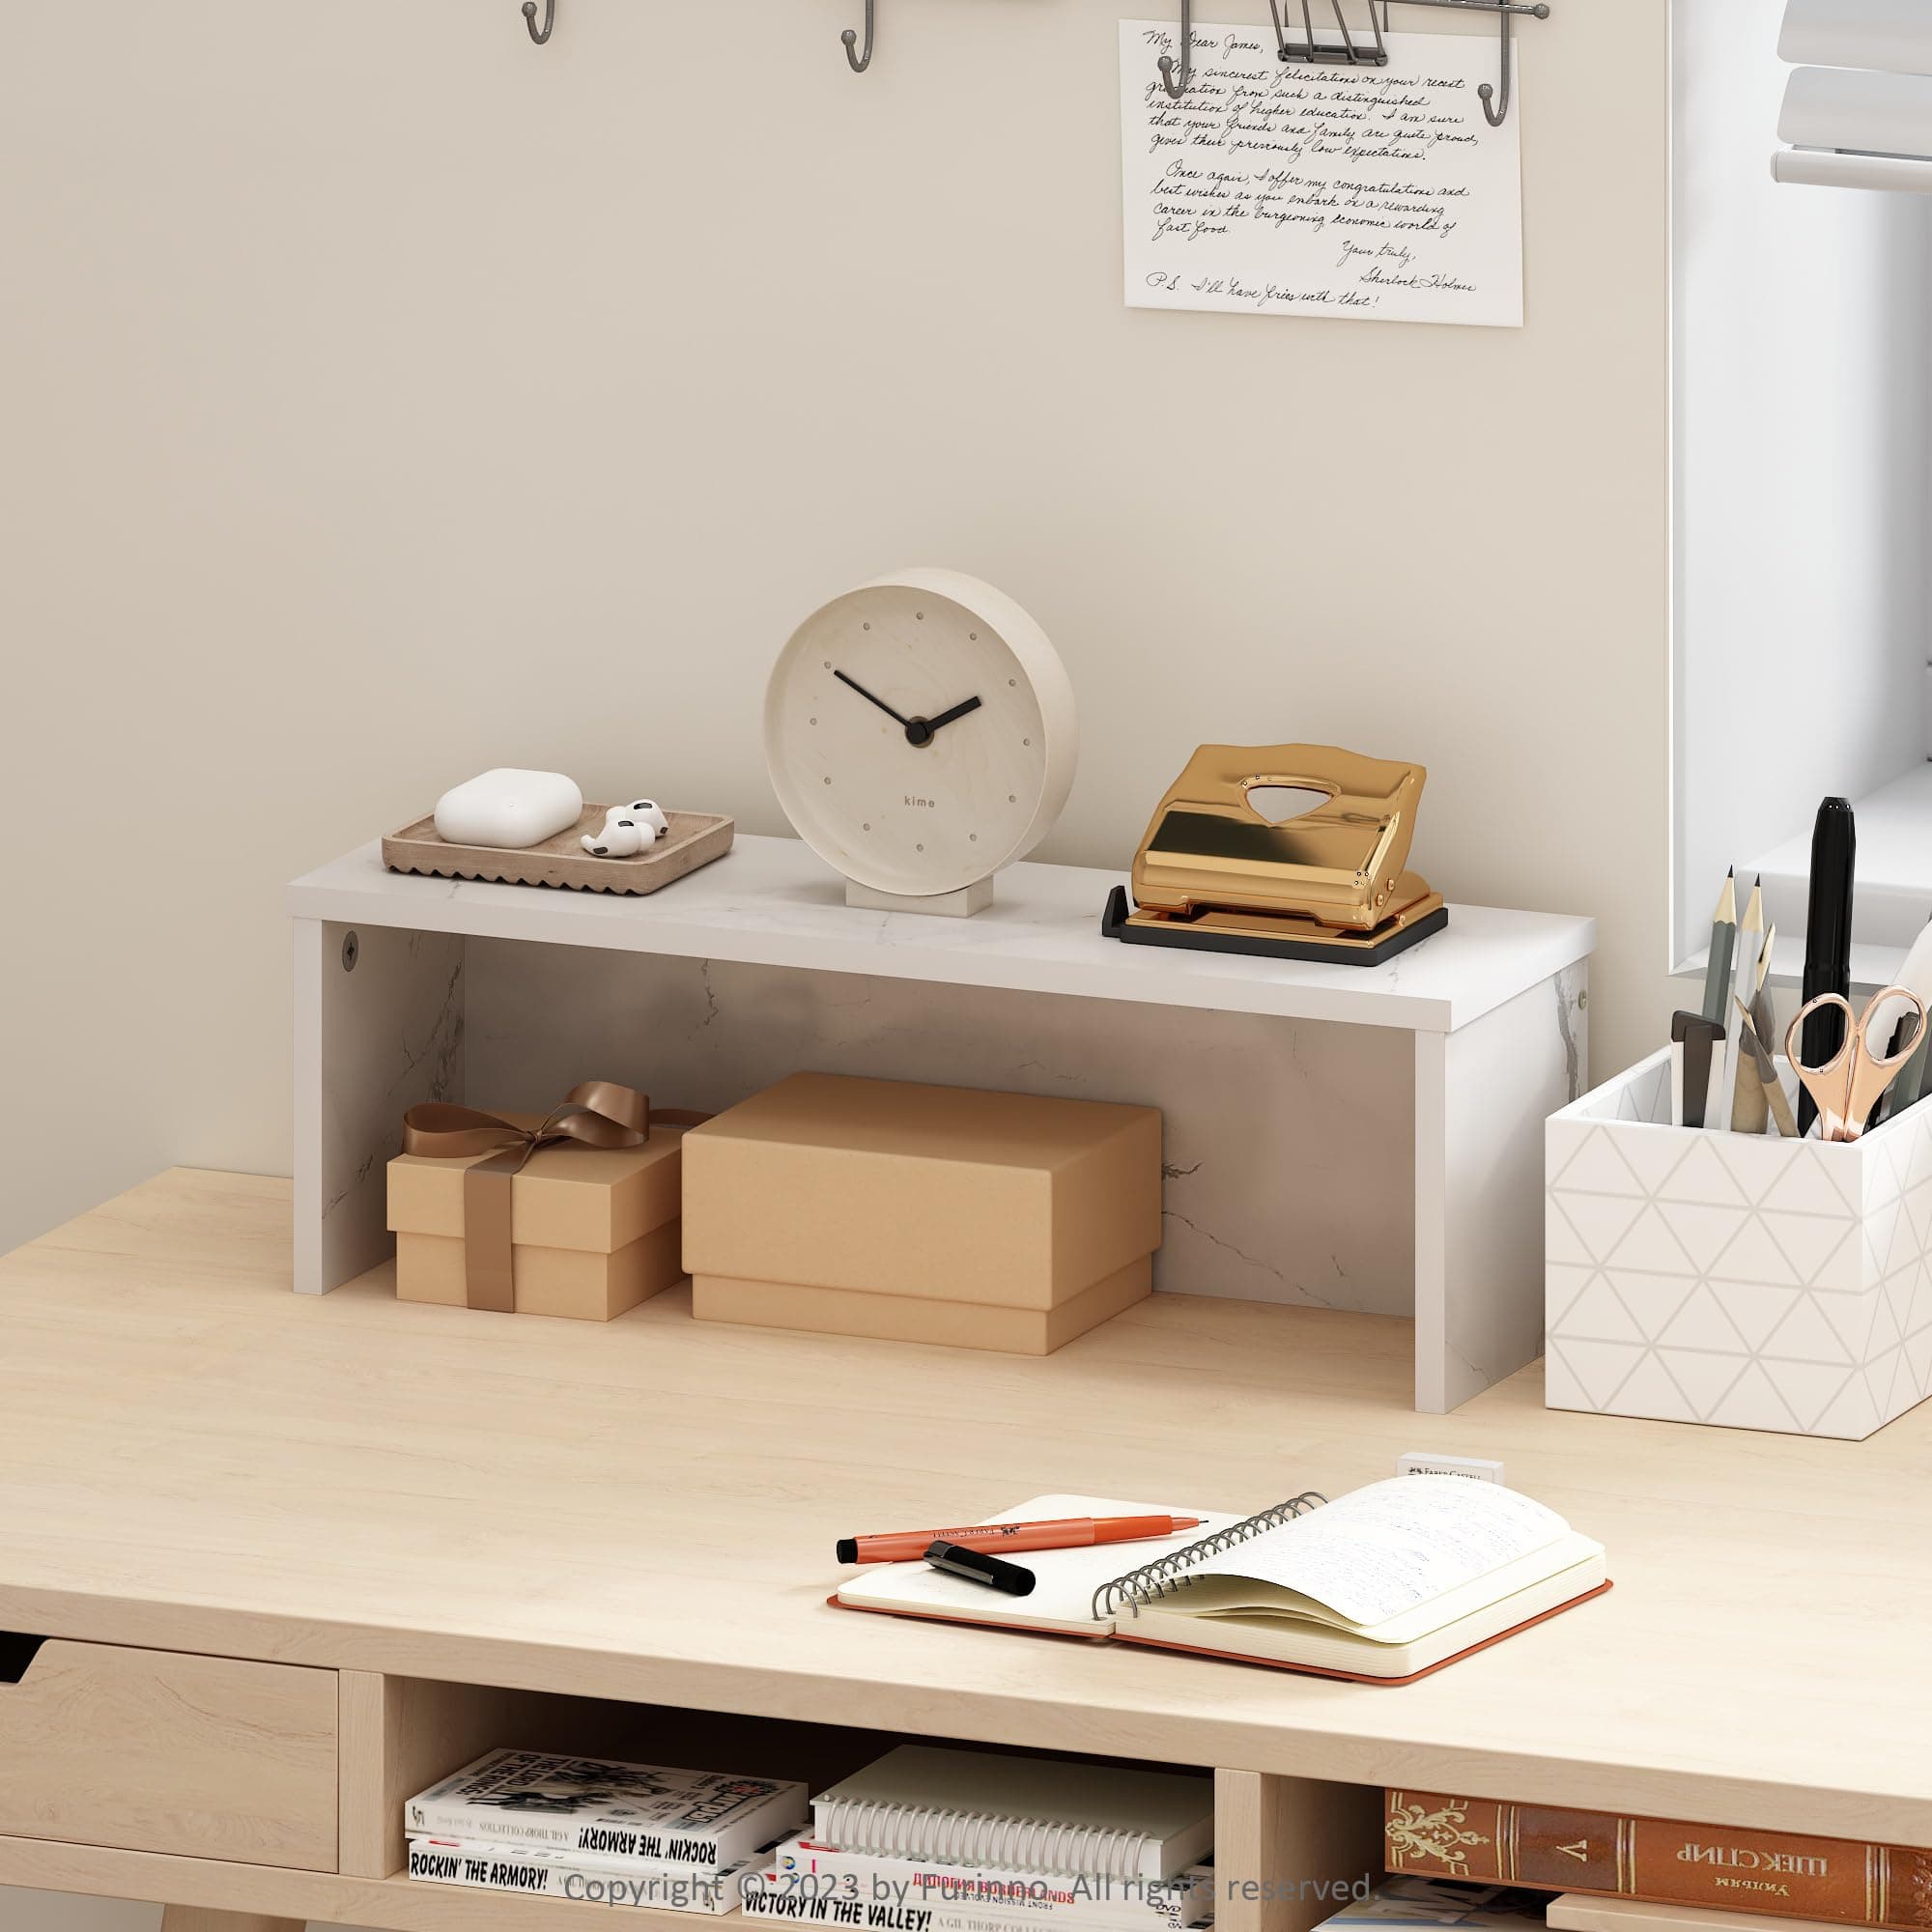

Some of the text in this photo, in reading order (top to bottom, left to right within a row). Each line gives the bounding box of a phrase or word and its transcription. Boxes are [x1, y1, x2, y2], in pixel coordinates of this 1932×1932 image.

[1143, 30, 1172, 54] My
[1223, 34, 1264, 59] James,
[1203, 68, 1268, 81] sincerest
[1270, 66, 1359, 88] felicitations
[1361, 76, 1381, 86] on
[1380, 75, 1420, 95] your
[1423, 77, 1465, 89] recent
[1145, 81, 1226, 100] gration
[1226, 85, 1269, 105] from
[1270, 86, 1308, 99] such
[1330, 91, 1431, 111] distinguished
[1147, 99, 1228, 113] institution
[1227, 101, 1249, 123] of
[1250, 99, 1295, 122] higher
[1382, 108, 1398, 120] I
[1401, 113, 1425, 123] am
[1429, 115, 1463, 124] sure
[1148, 111, 1479, 148] that your friends and family are quite proud,
[1190, 134, 1226, 146] their
[1229, 140, 1303, 163] previously
[1311, 139, 1342, 154] low
[1342, 145, 1427, 162] expectations.
[1166, 159, 1470, 199] Once again, I offer my congratulations and
[1150, 179, 1445, 221] best wishes as you embark on a rewarding
[1151, 217, 1191, 241] fast
[1152, 203, 1457, 238] career in the burgeoning economic world of
[1376, 242, 1416, 268] truly,
[1191, 278, 1224, 294] I'll
[1227, 277, 1262, 298] have
[1257, 283, 1299, 306] fries
[1299, 290, 1336, 302] with
[1338, 291, 1379, 307] that!
[1359, 267, 1476, 292] Sherlock Holmes
[904, 796, 935, 808] kime
[489, 1762, 528, 1776] THE
[513, 1753, 543, 1763] OF
[531, 1756, 572, 1771] THE
[505, 1769, 547, 1786] LORD
[579, 1827, 717, 1864] ROCKIN' THE ARMORY!
[1676, 1842, 1828, 1877] ШЕКСПИР
[411, 1853, 463, 1879] ROCKIN'
[465, 1860, 489, 1882] THE
[490, 1863, 549, 1890] ARMORY!
[1715, 1877, 1790, 1897] Уильям
[745, 1891, 809, 1918] VICTORY
[810, 1898, 828, 1919] IN
[834, 1900, 863, 1924] THE
[868, 1904, 932, 1932] VALLEY!
